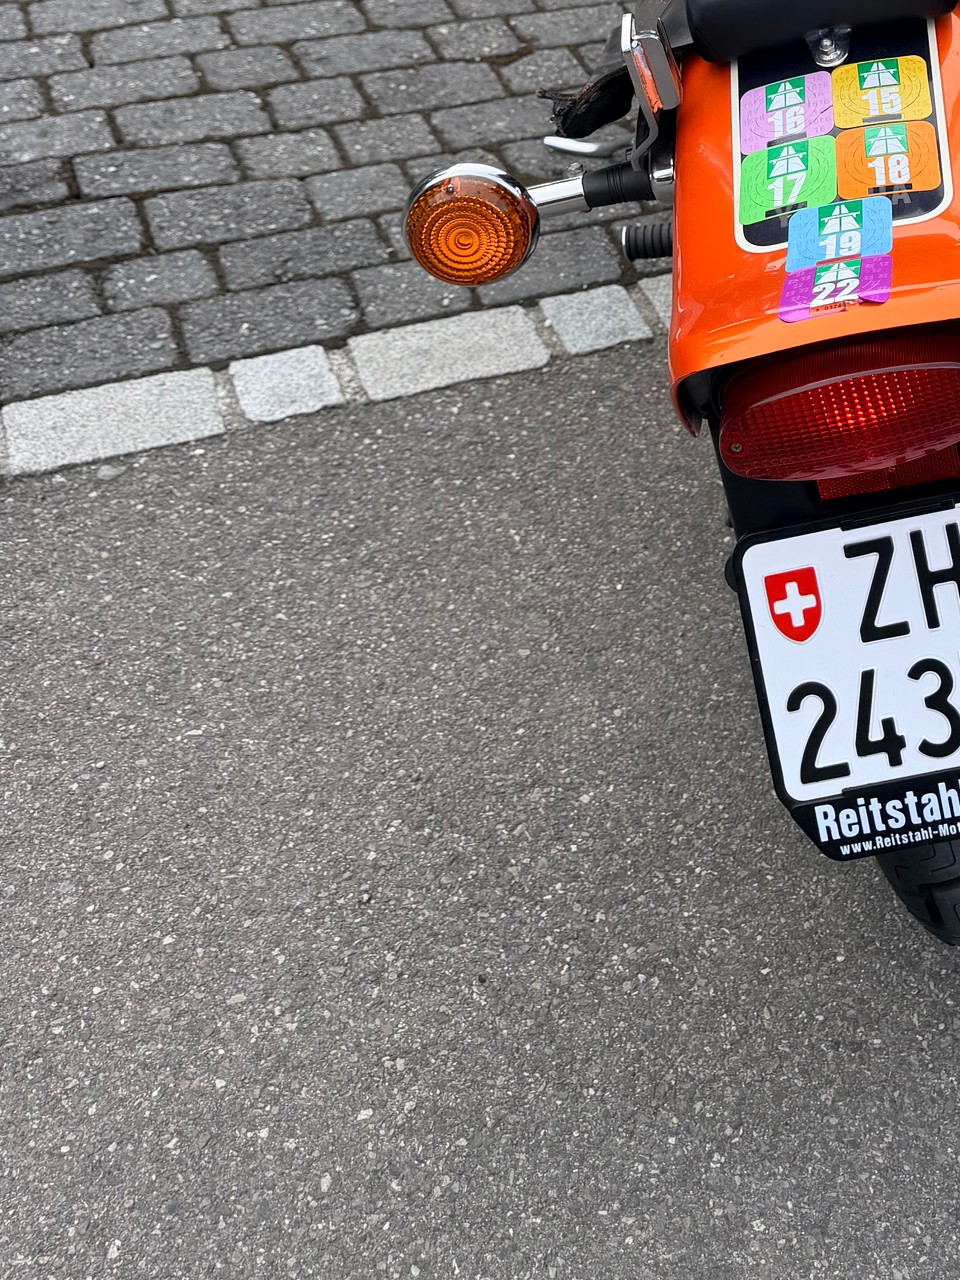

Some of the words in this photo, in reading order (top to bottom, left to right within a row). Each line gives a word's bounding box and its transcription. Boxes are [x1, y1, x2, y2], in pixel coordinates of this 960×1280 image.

[861, 87, 902, 116] 15
[767, 105, 805, 138] 16
[867, 153, 910, 186] 18
[767, 171, 807, 207] 17
[819, 230, 861, 260] 19
[809, 278, 860, 308] 22
